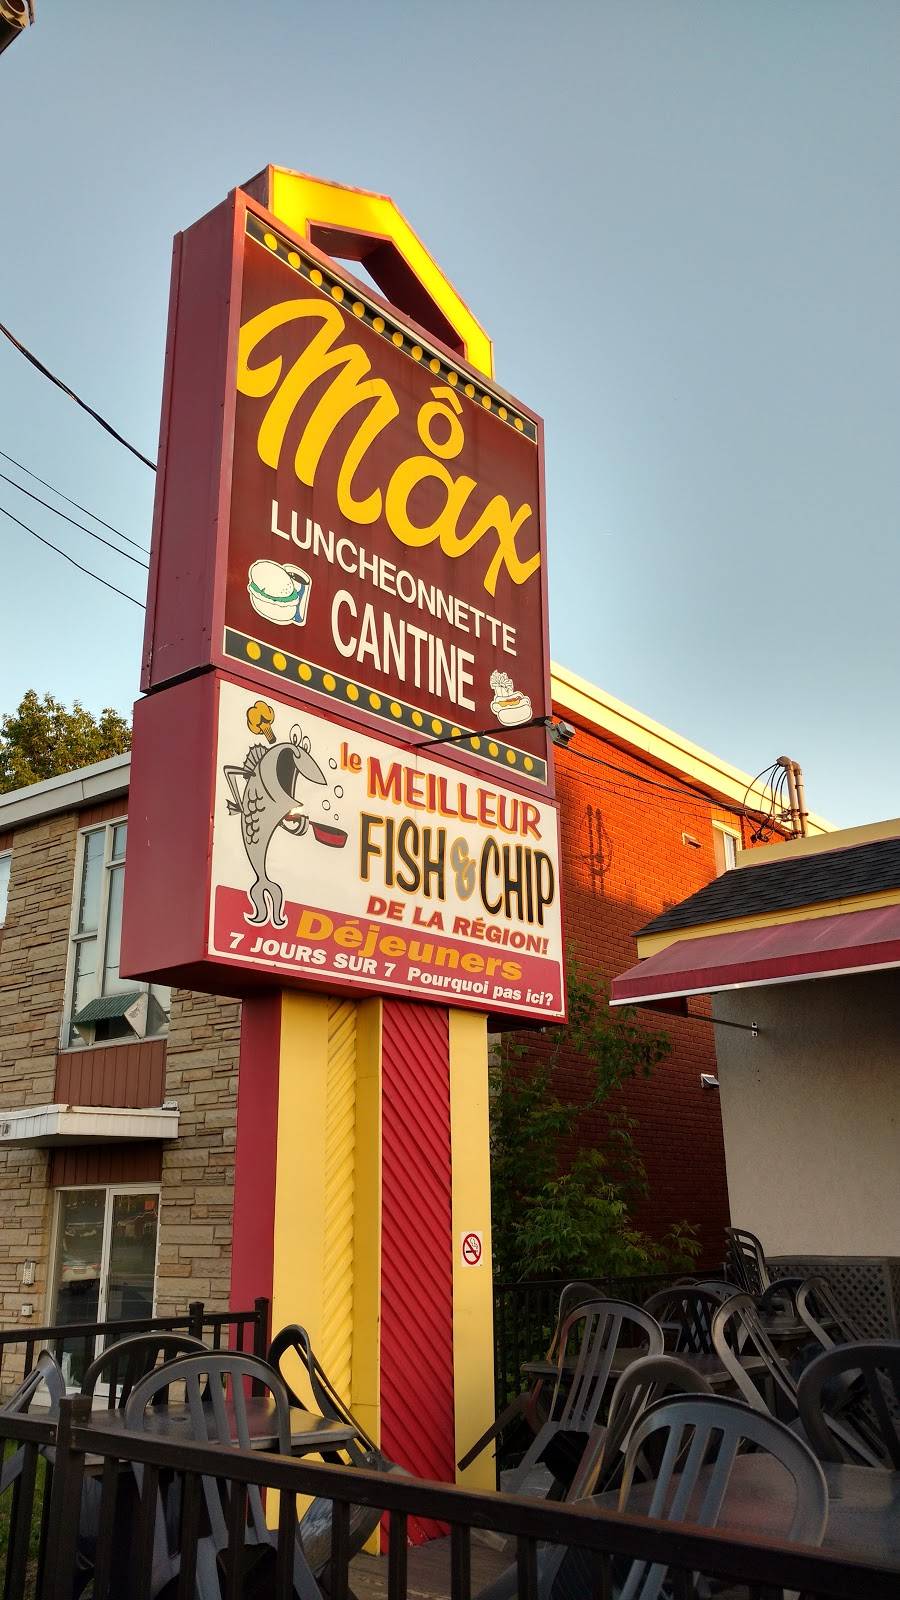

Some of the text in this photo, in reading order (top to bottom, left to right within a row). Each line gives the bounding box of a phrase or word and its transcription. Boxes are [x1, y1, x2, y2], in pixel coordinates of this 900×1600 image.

[270, 499, 517, 656] LUNCHEONNETTE
[331, 589, 476, 711] CANTINE
[340, 742, 542, 841] le MEILLEUR
[359, 811, 555, 927] FISH & CHIP
[229, 931, 553, 1006] 7 JOURS SUR 7 Pourquoi pas ici?
[296, 909, 523, 981] Déjeuners
[366, 895, 549, 955] DE LA RÉGION!
